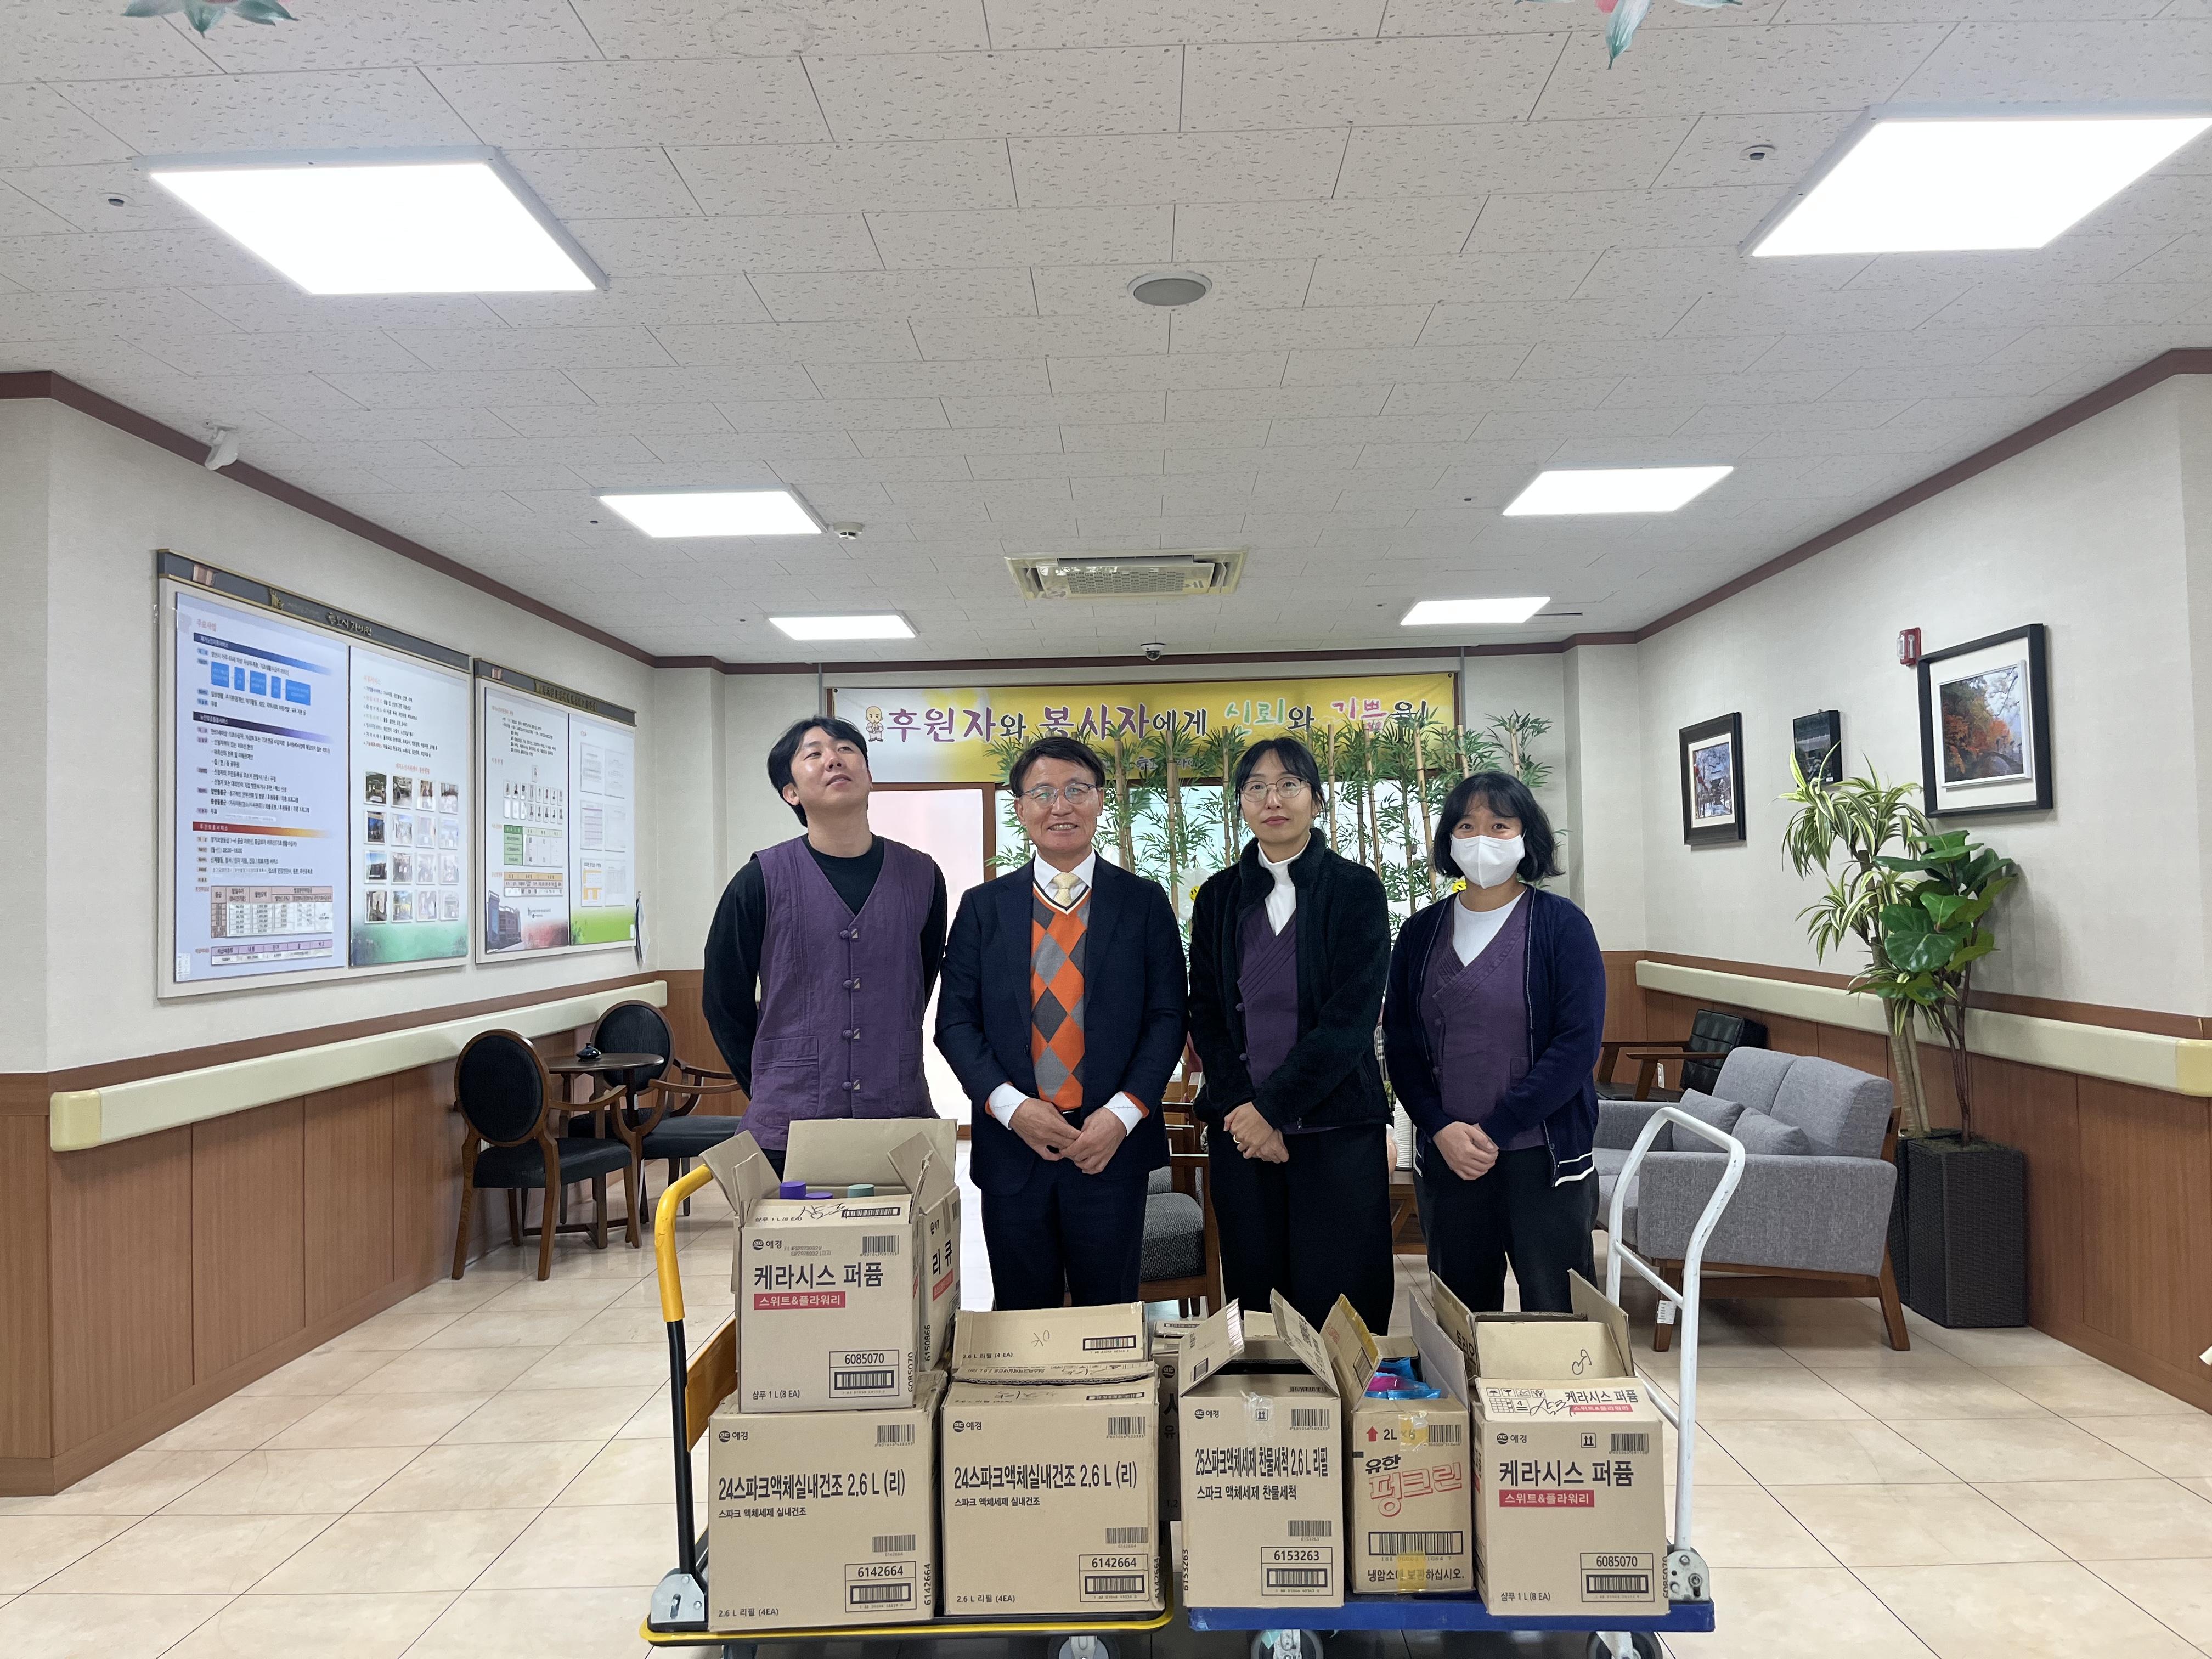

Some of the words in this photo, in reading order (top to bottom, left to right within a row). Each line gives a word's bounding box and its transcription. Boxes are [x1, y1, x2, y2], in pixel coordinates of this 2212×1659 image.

[888, 706, 1027, 743] 후원자와
[1039, 703, 1206, 741] 봉사자에게
[1225, 697, 1316, 736] 신뢰와
[766, 1240, 782, 1249] 애경
[754, 1263, 836, 1290] 케라시스
[843, 1262, 884, 1288] 퍼퓸
[759, 1294, 840, 1307] 스위트&플라워리
[844, 1353, 885, 1365] 6085070
[752, 1391, 766, 1400] 샴푸
[1565, 1391, 1613, 1404] 케라시스
[1616, 1390, 1639, 1403] 퍼퓸
[1206, 1410, 1220, 1419] 애경
[966, 1421, 982, 1431] 애경
[732, 1431, 748, 1441] 애경
[1384, 1429, 1397, 1440] 2L
[1510, 1435, 1527, 1444] 애경
[1195, 1447, 1256, 1477] 25스파크액체세제
[1259, 1447, 1288, 1477] 찬물세척
[1291, 1448, 1303, 1477] 2.6
[1306, 1448, 1311, 1475] L
[1313, 1447, 1328, 1477] 리필
[1365, 1454, 1401, 1474] 유한
[955, 1464, 1076, 1490] 24스파크액체실내건조
[1080, 1464, 1099, 1487] 2.6
[1104, 1464, 1111, 1486] L
[1116, 1461, 1137, 1489] (리)
[1499, 1460, 1583, 1486] 케라시스
[1592, 1460, 1634, 1486] 퍼퓸
[719, 1473, 843, 1500] 24스파크액체실내건조
[848, 1472, 867, 1497] 2.6
[872, 1472, 879, 1494] L
[884, 1469, 905, 1497] (리)
[1368, 1462, 1462, 1517] 펑크린
[1197, 1485, 1222, 1500] 스파크
[1226, 1485, 1260, 1500] 액체세제
[1262, 1485, 1296, 1500] 찬물세척
[955, 1498, 977, 1506] 스파크
[979, 1497, 1008, 1506] 액체세제
[1011, 1497, 1040, 1506] 실내건조
[1505, 1493, 1589, 1504] 스위트&플라워리
[718, 1509, 742, 1519] 스파크
[744, 1508, 774, 1518] 액체세제
[776, 1506, 807, 1517] 실내건조
[1274, 1550, 1319, 1561] 6153263
[1092, 1558, 1137, 1568] 6142664
[1596, 1556, 1638, 1567] 6085070
[858, 1565, 904, 1577] 6142664
[977, 1594, 992, 1603] 리필
[995, 1594, 1015, 1603] (4EA)
[1500, 1592, 1515, 1601] 샴푸
[740, 1608, 755, 1617] 리필
[758, 1608, 778, 1617] (4EA)
